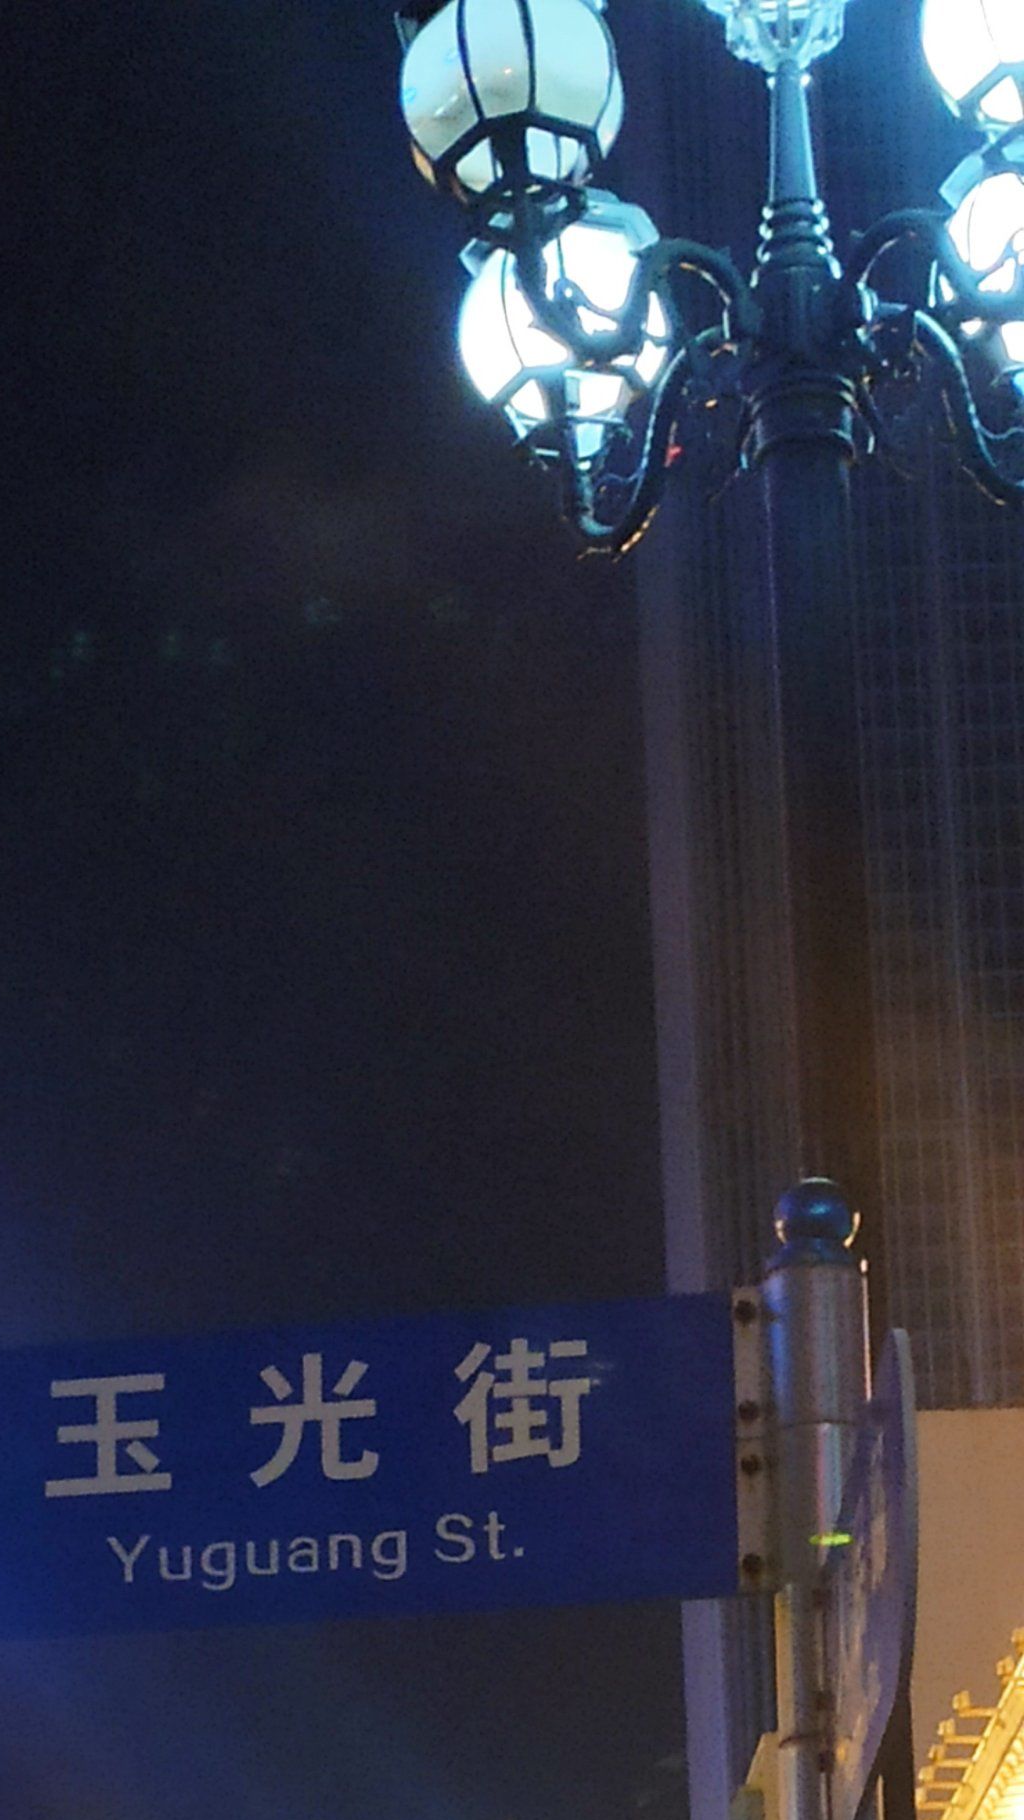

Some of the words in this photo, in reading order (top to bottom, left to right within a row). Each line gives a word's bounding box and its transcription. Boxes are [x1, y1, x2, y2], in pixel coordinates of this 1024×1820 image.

[44, 1338, 589, 1498] 玉光街
[107, 1524, 408, 1591] Yuguang
[434, 1511, 525, 1565] St.
